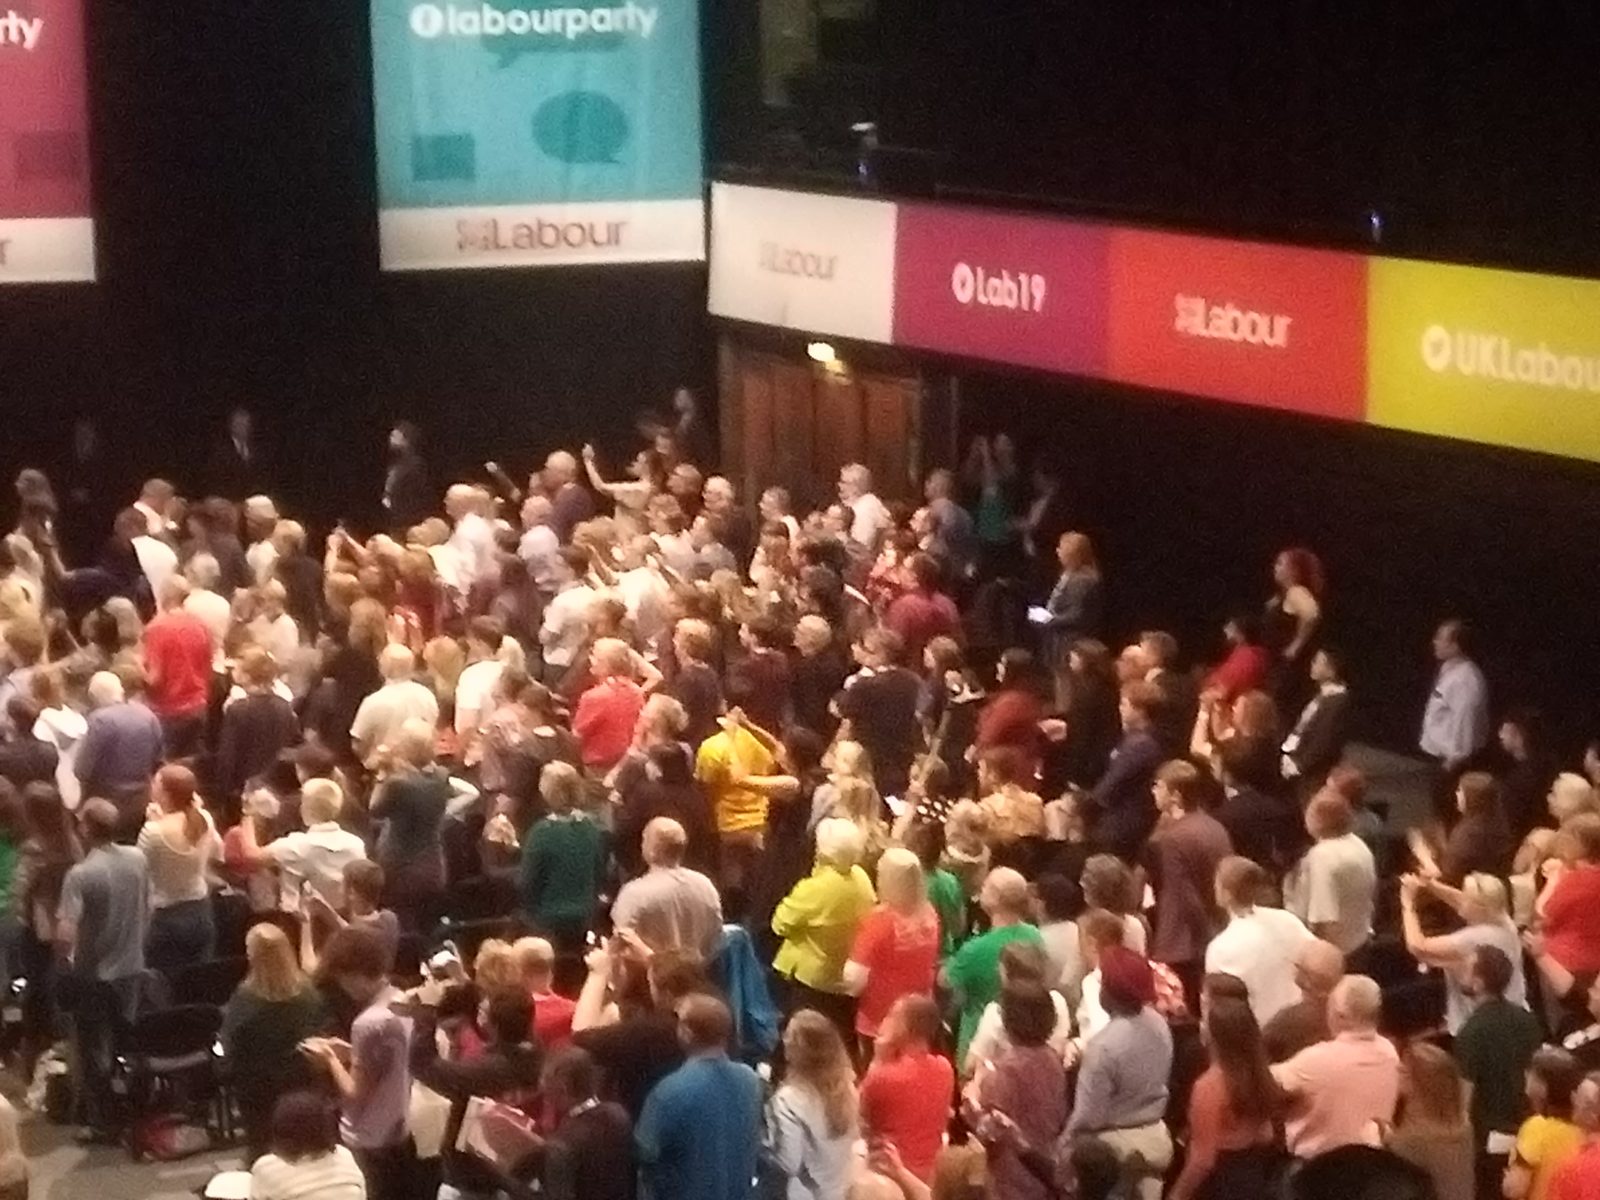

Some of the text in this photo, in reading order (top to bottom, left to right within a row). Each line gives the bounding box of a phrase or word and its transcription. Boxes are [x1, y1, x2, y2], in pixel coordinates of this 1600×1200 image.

[449, 2, 658, 39] labourparty
[492, 218, 628, 251] Labour
[976, 266, 1046, 312] Lab19
[1198, 298, 1293, 348] Labour
